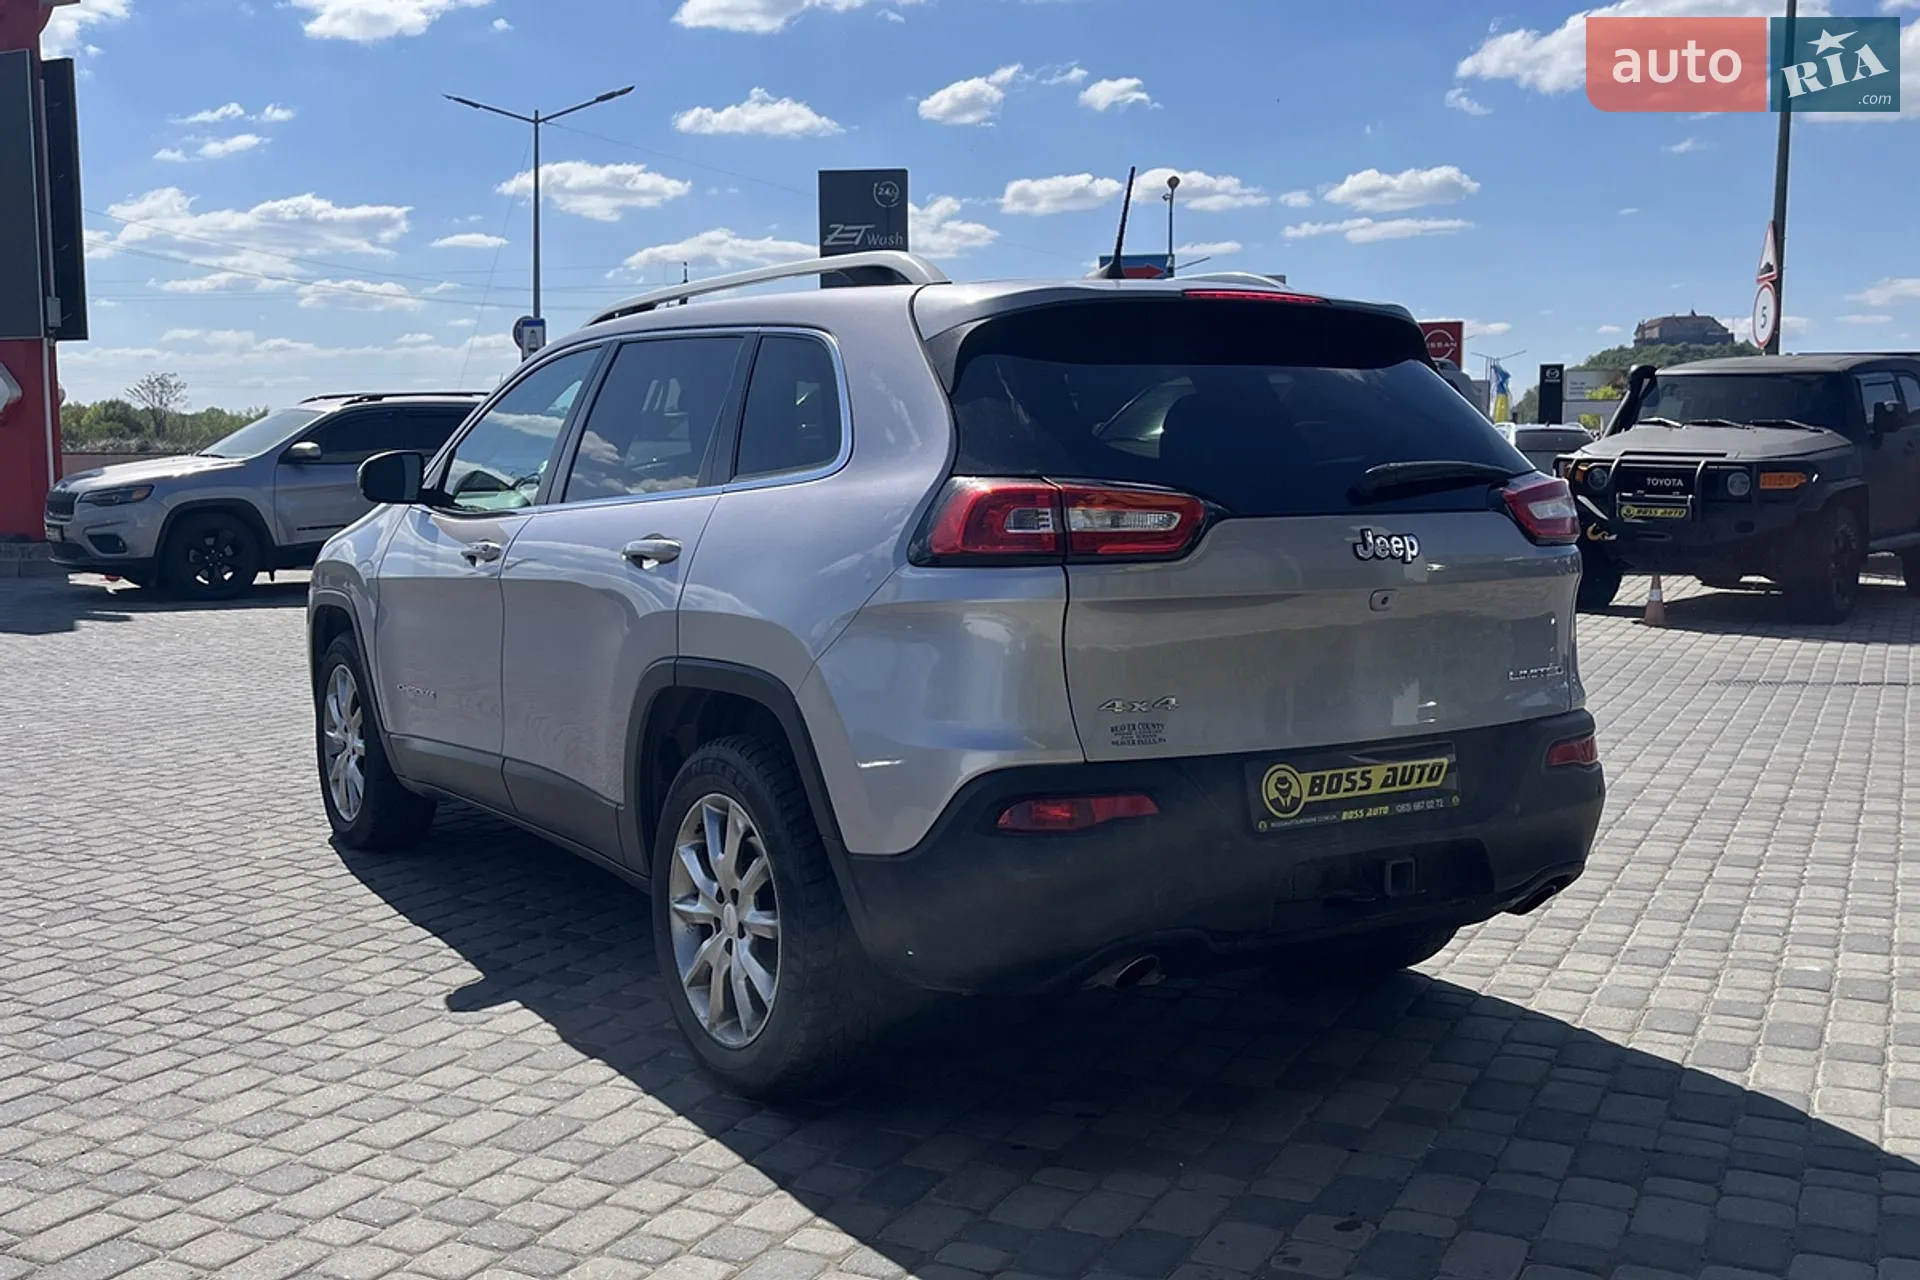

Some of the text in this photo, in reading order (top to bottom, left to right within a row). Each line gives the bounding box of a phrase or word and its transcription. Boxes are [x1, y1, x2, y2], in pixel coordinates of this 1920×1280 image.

[823, 224, 904, 246] ZET Wash
[1760, 306, 1768, 329] 5
[1646, 478, 1684, 487] TOYOTA
[1354, 528, 1420, 564] Jeep
[1098, 696, 1179, 713] 4x4
[1307, 760, 1445, 797] BOSS AUTO
[1341, 809, 1365, 821] BOSS
[1366, 806, 1389, 817] AUTO
